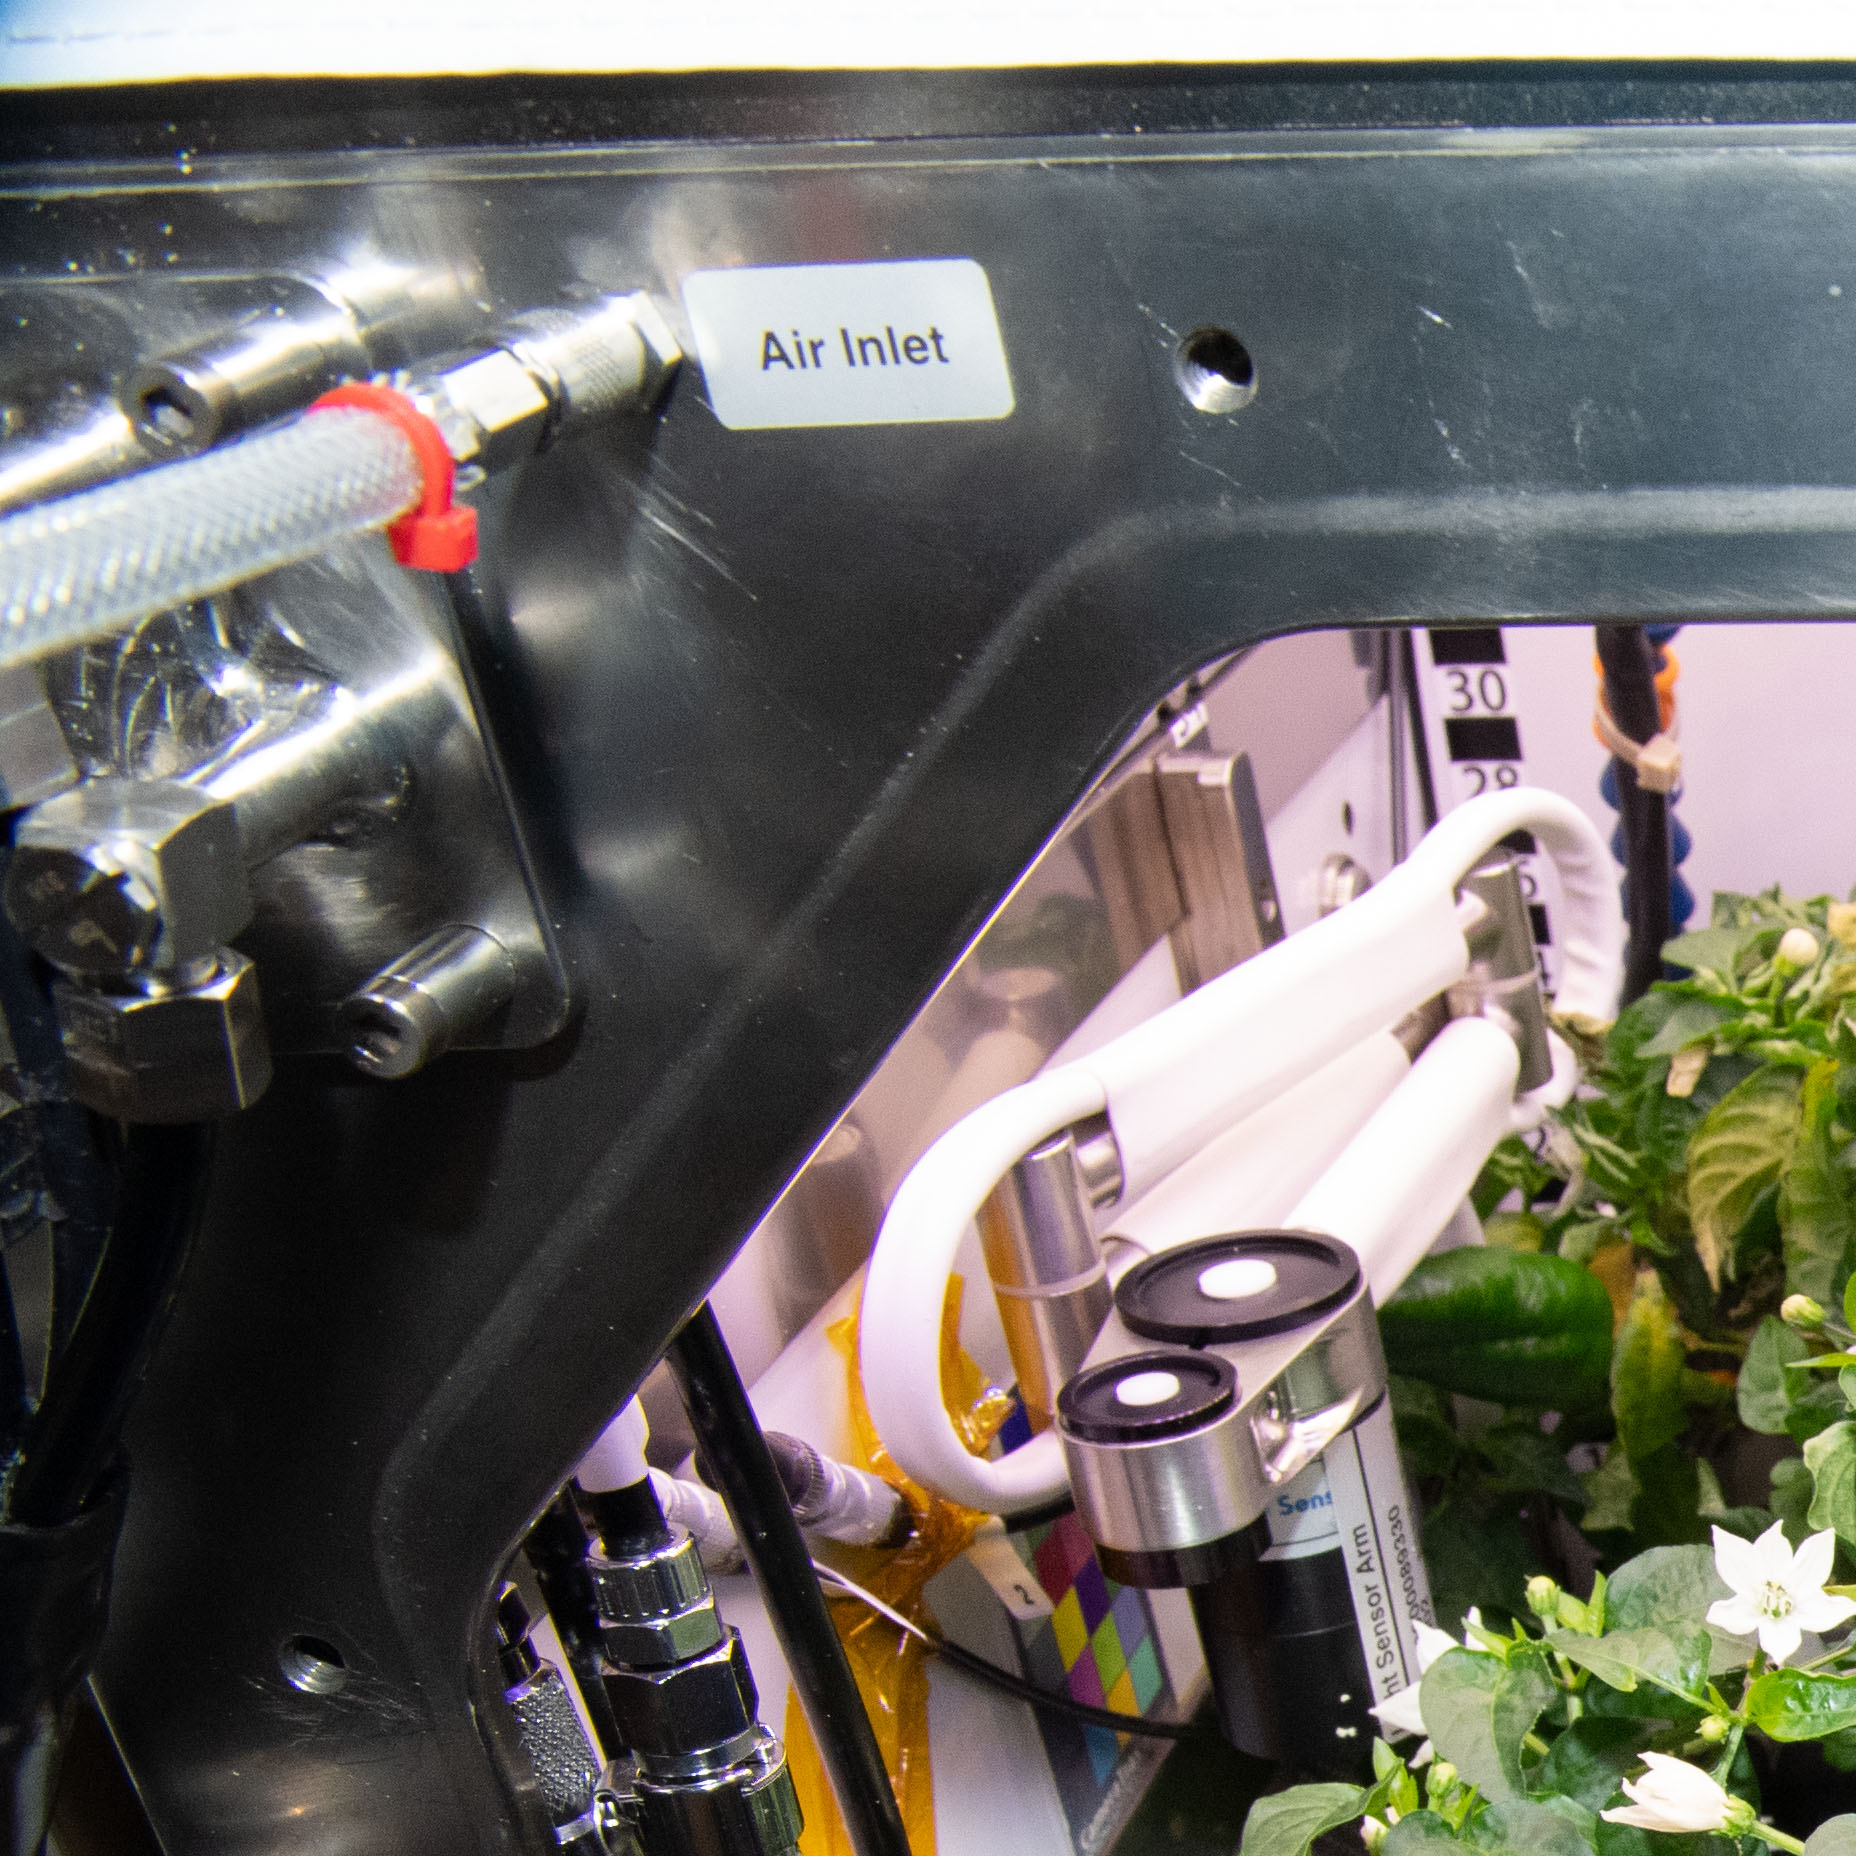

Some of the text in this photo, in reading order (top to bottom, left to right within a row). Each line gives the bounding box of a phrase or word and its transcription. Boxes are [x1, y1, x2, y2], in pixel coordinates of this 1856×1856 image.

[762, 324, 950, 371] Air Inlet
[1447, 669, 1506, 712] 30
[1352, 1522, 1396, 1671] Sensor Arm
